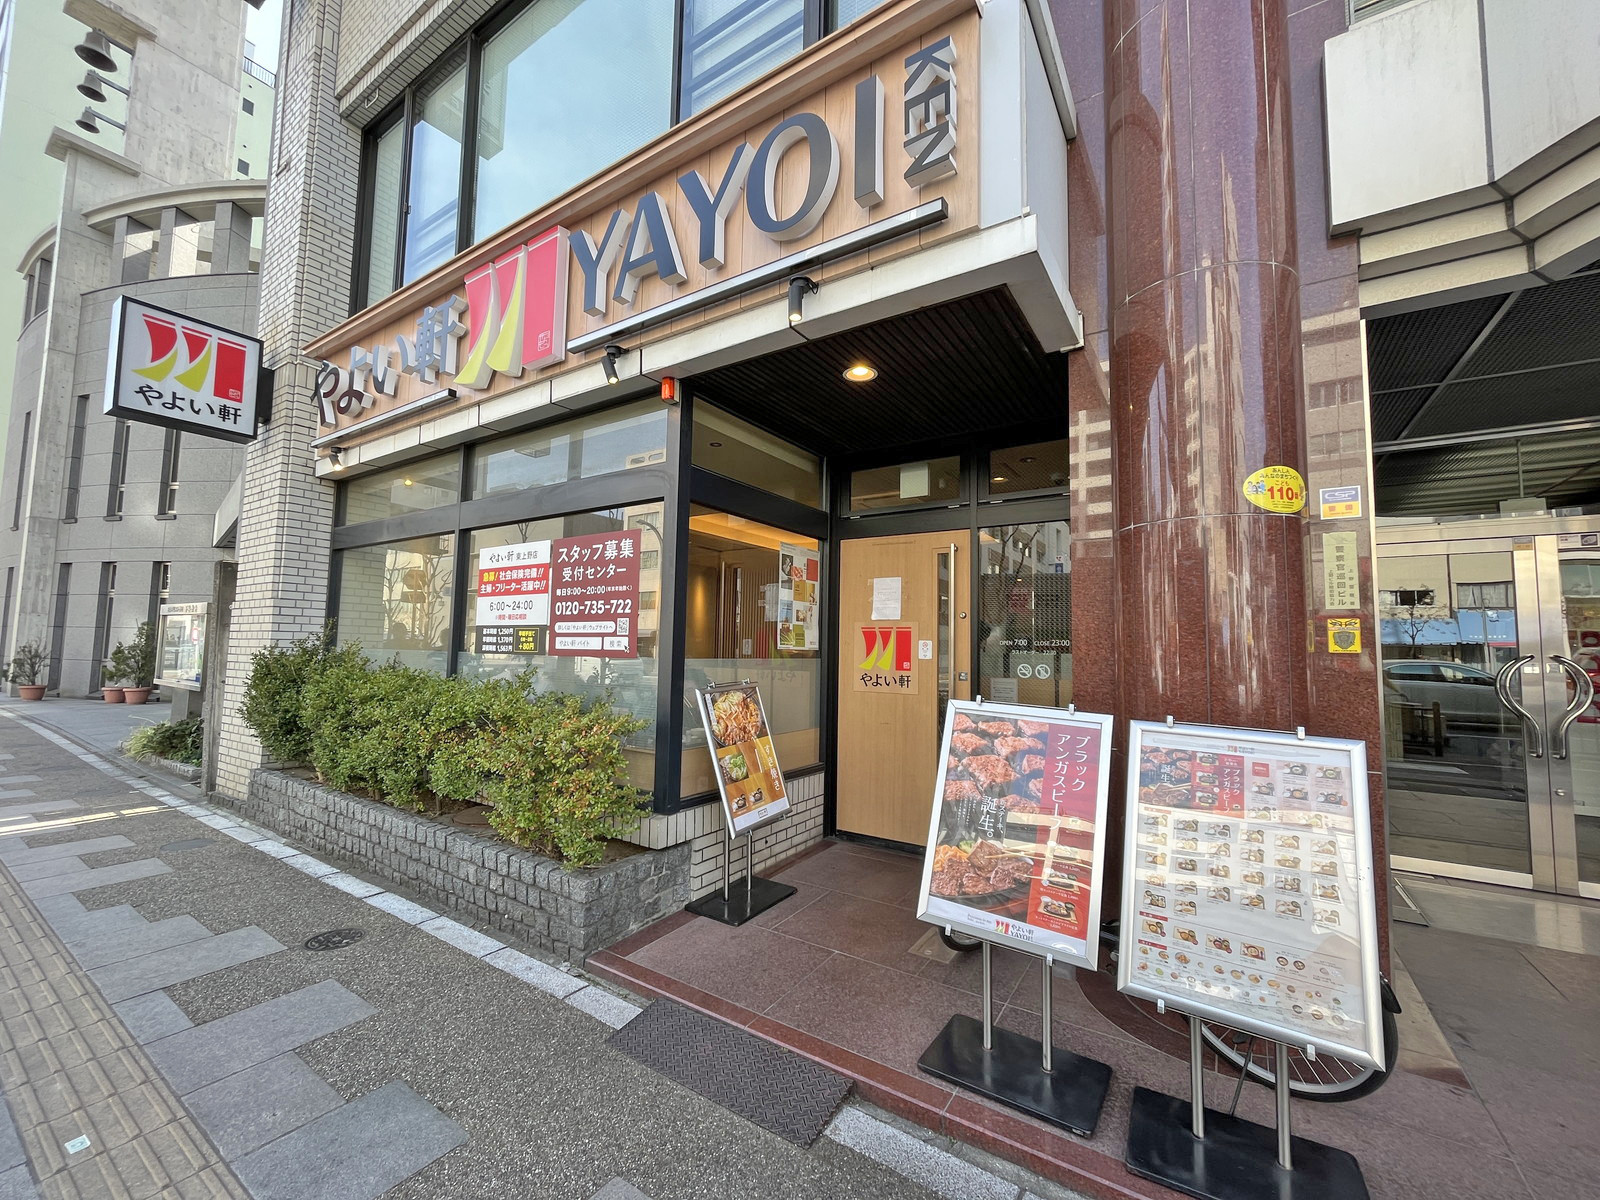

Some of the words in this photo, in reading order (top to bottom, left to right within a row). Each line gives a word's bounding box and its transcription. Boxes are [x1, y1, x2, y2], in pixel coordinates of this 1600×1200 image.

[903, 35, 957, 188] KEN
[568, 75, 883, 316] YAYOI
[311, 294, 467, 428] やよい軒
[134, 383, 242, 425] やよい軒
[489, 550, 514, 563] やよい軒
[557, 538, 634, 563] スタッフ募集
[562, 563, 627, 582] 受付センター
[555, 599, 632, 615] 0120-735-722
[860, 673, 911, 688] やよい軒
[1049, 733, 1071, 830] アンガスビーフ
[1072, 736, 1091, 791] ブラック
